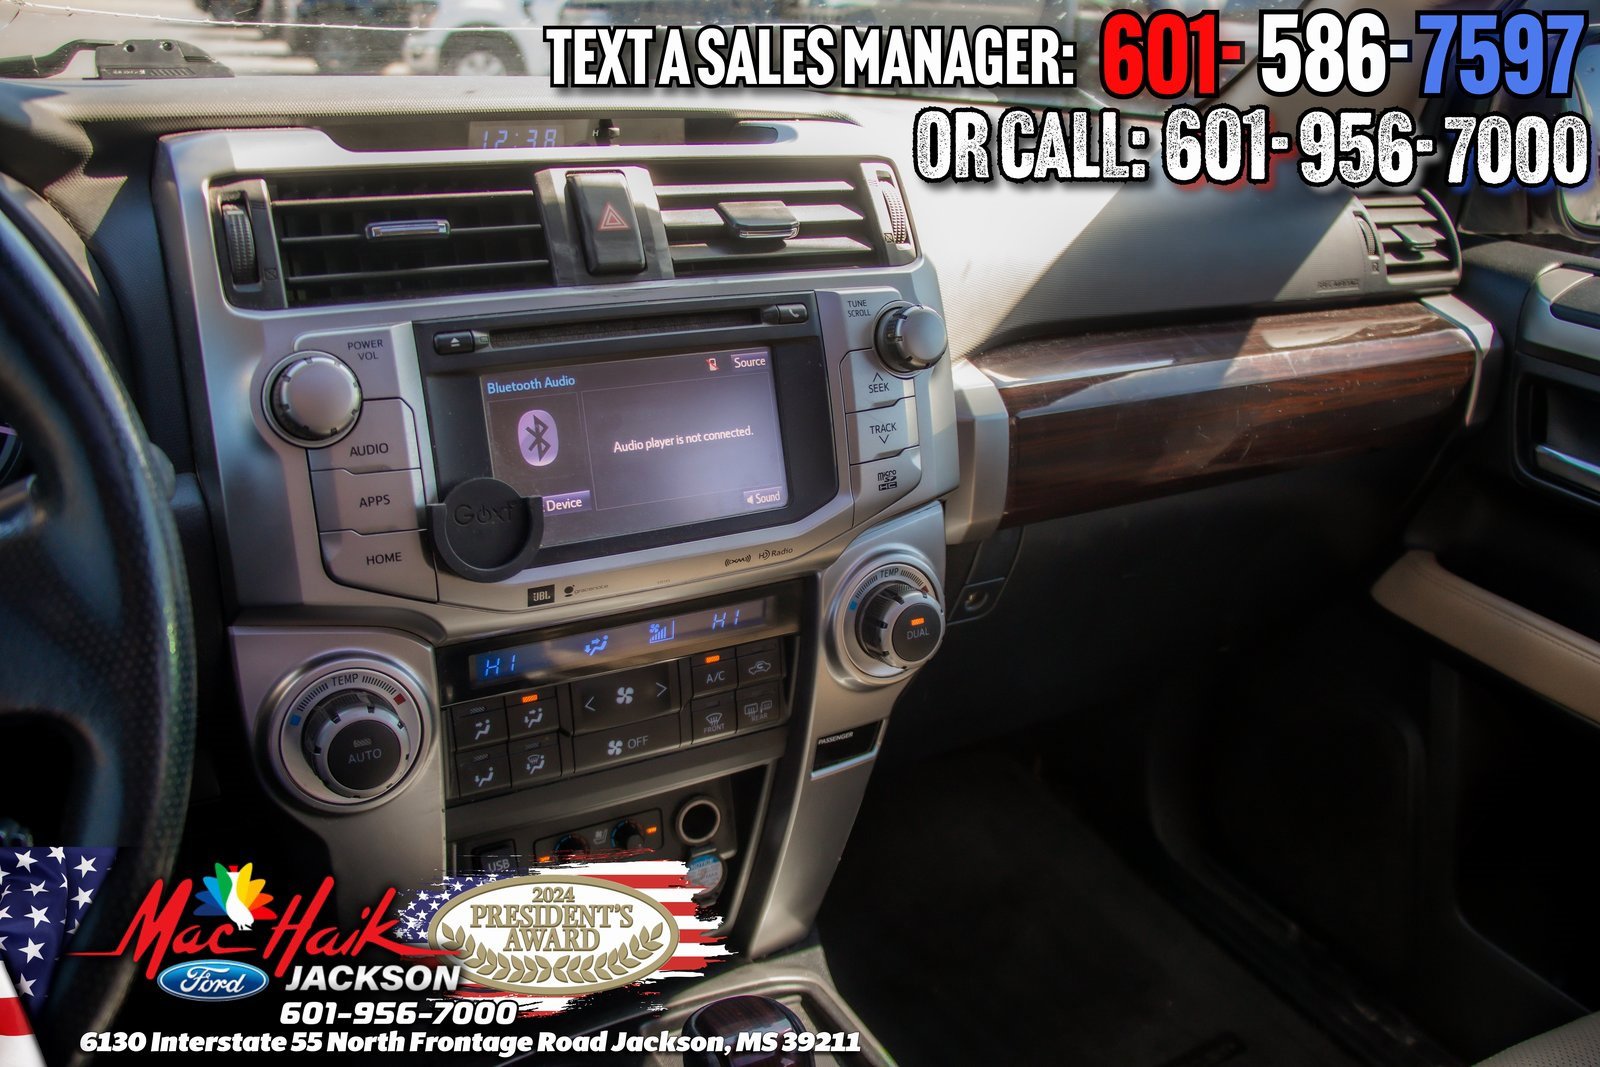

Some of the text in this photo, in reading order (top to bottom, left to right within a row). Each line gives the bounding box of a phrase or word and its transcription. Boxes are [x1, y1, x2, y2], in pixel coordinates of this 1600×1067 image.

[847, 299, 867, 308] TUNE
[847, 308, 872, 318] SCROLL
[347, 339, 384, 351] POWER
[358, 351, 379, 361] VOL
[733, 356, 766, 369] Source
[486, 375, 576, 395] Bluetooth Audio
[868, 382, 890, 394] SEEK
[869, 422, 897, 435] TRACK
[613, 425, 754, 454] Audio player is not connected.
[349, 442, 389, 458] AUDIO
[358, 494, 391, 509] APPS
[755, 491, 781, 505] Sound
[546, 498, 583, 512] Device
[771, 547, 794, 557] Radio
[365, 551, 402, 567] HOME
[880, 567, 899, 579] TEMP
[533, 590, 551, 602] JBL
[906, 627, 930, 640] DUAL
[331, 673, 359, 687] TEMP
[706, 670, 725, 684] A/C
[751, 711, 769, 722] REAR
[703, 722, 725, 734] FRONT
[627, 735, 649, 750] OFF
[818, 731, 854, 745] PASSENGER
[347, 748, 382, 764] AUTO
[488, 858, 510, 872] USB
